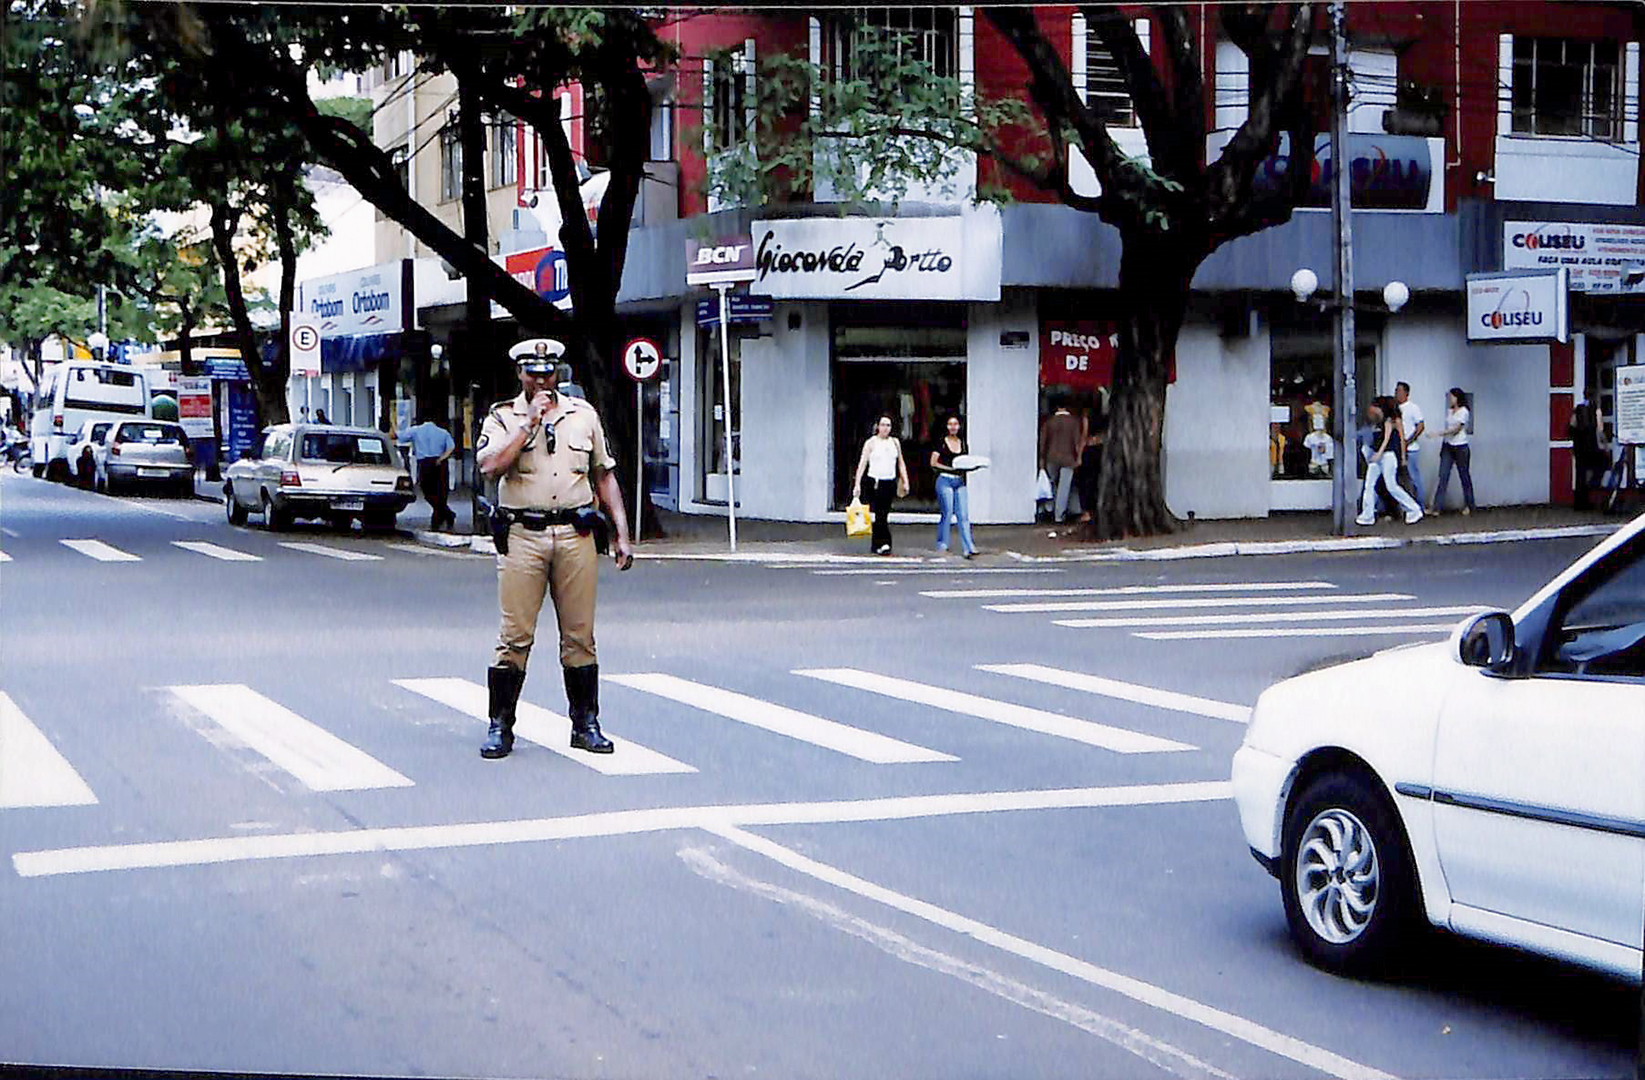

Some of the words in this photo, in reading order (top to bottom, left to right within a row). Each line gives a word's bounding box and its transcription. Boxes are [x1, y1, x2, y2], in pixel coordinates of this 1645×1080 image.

[1512, 233, 1585, 250] COLISEU
[693, 245, 746, 265] BCN
[756, 230, 864, 282] Gioconda
[1481, 311, 1543, 329] COLISEU
[300, 331, 310, 346] E
[1050, 330, 1100, 352] PREÇO
[1065, 354, 1089, 371] DE
